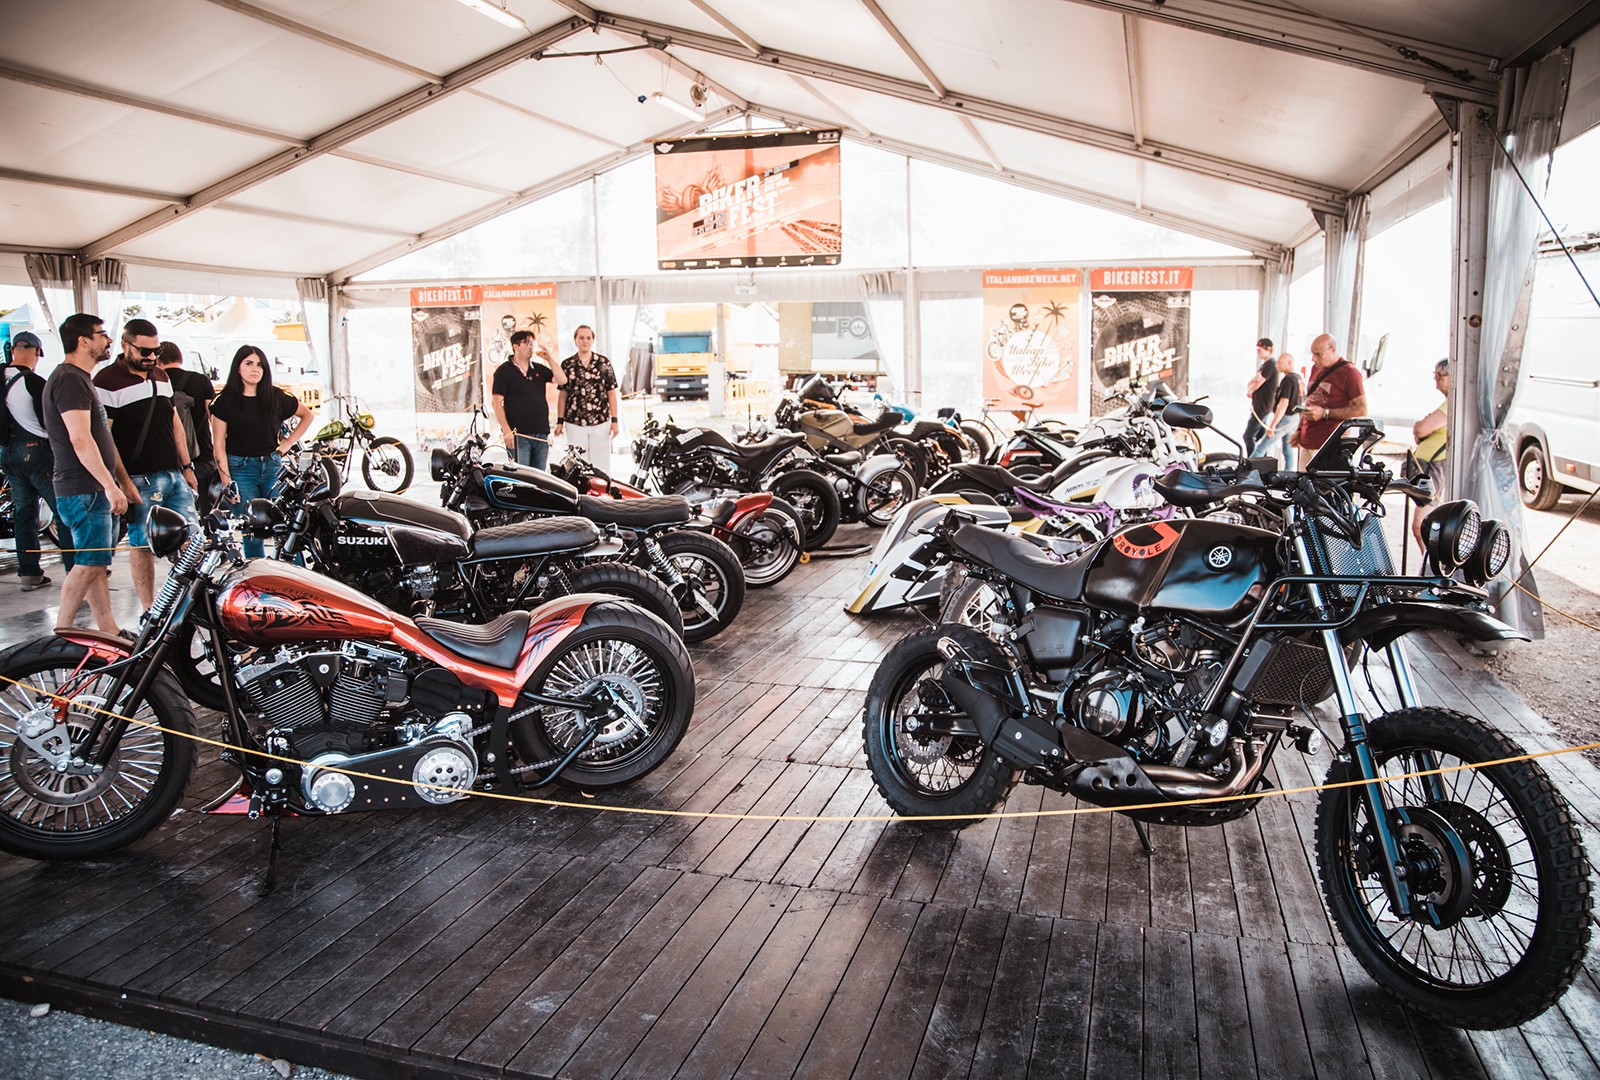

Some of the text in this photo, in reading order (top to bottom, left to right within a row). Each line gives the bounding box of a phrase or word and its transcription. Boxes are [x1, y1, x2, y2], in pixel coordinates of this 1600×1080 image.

[699, 174, 760, 217] BIKER
[729, 190, 778, 230] FEST
[985, 274, 1077, 284] ITALIANBIKEWEEK.NET
[1103, 270, 1180, 285] BIKERFEST.IT
[418, 289, 473, 303] BIKERFEST.IT
[423, 342, 463, 372] BIKER
[1103, 333, 1162, 368] BIKER
[1129, 348, 1176, 379] FEST
[441, 353, 472, 381] FEST
[337, 535, 388, 546] SUZUKI
